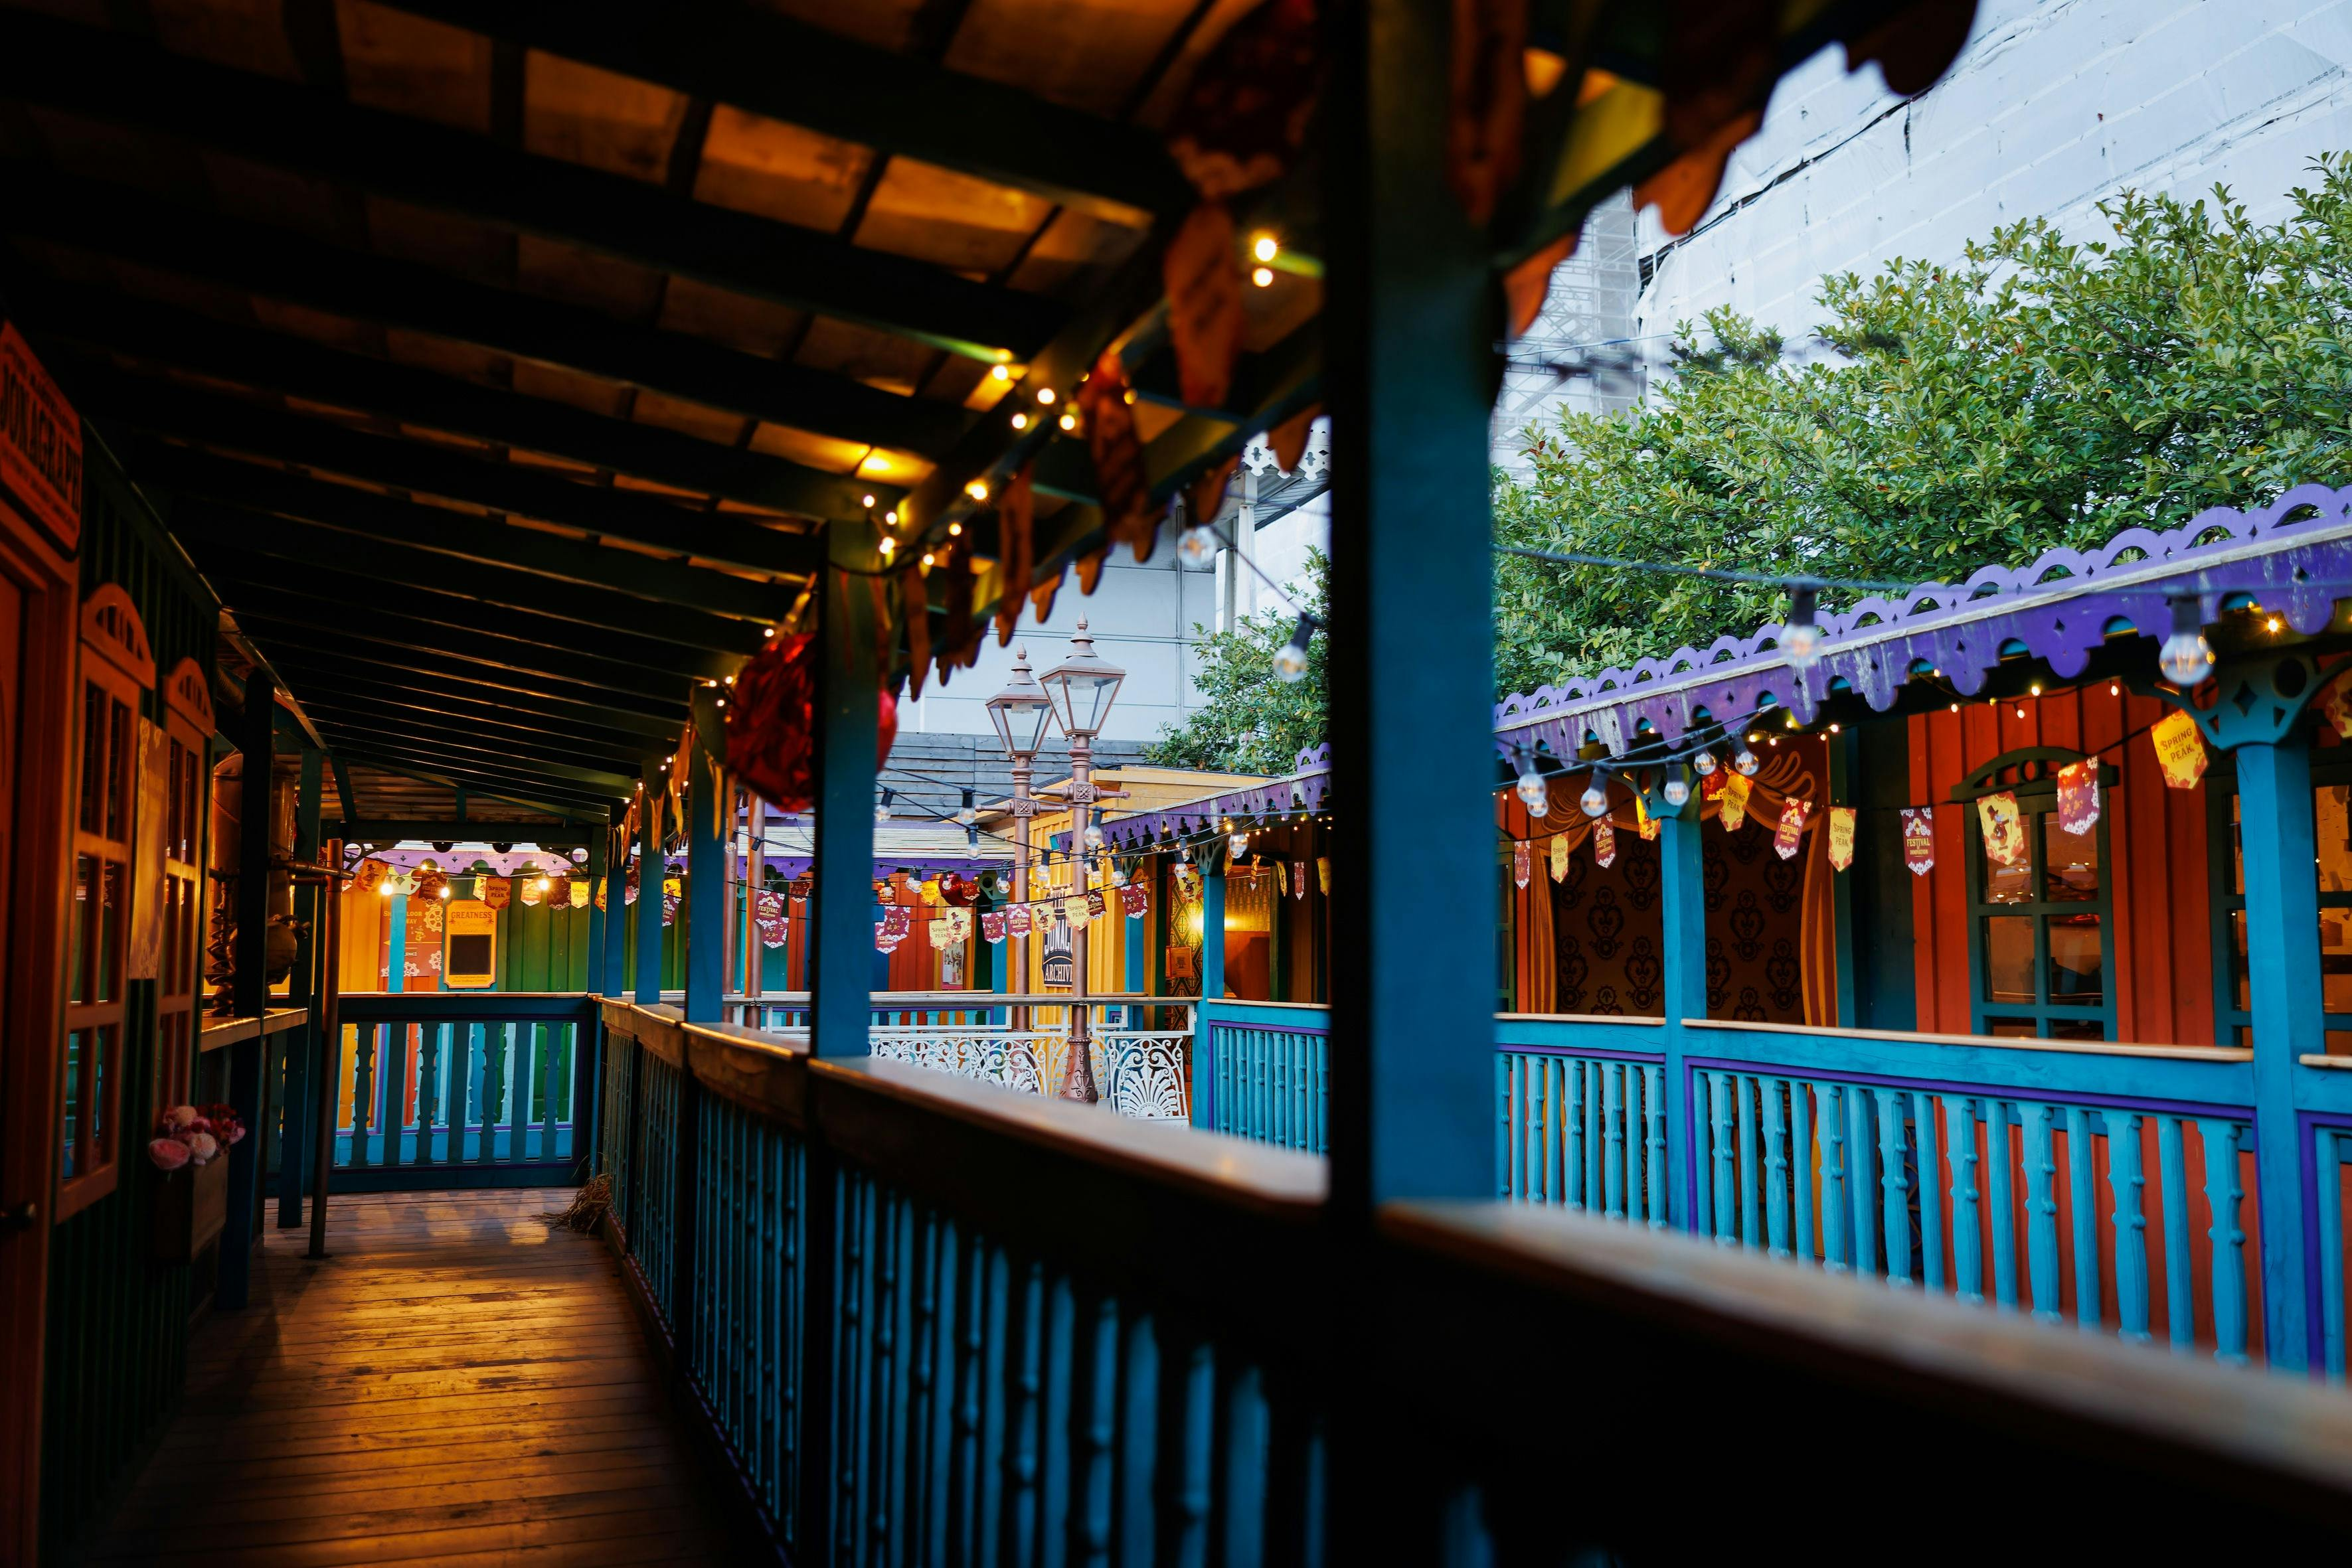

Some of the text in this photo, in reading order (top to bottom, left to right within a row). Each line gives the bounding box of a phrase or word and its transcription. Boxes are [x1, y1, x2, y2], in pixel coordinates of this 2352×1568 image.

[2161, 728, 2193, 751] SPRING
[2170, 744, 2195, 762] PEAK
[1727, 786, 1746, 802] SPRING
[1727, 799, 1740, 813] PEAK
[1780, 823, 1799, 836] FESTIVAL
[1833, 823, 1851, 834] SPRING
[1596, 836, 1613, 848] FESTIVAL
[1835, 836, 1849, 846] PEAK
[1906, 837, 1931, 847] FESTIVAL
[758, 905, 779, 914] FESTIVAL
